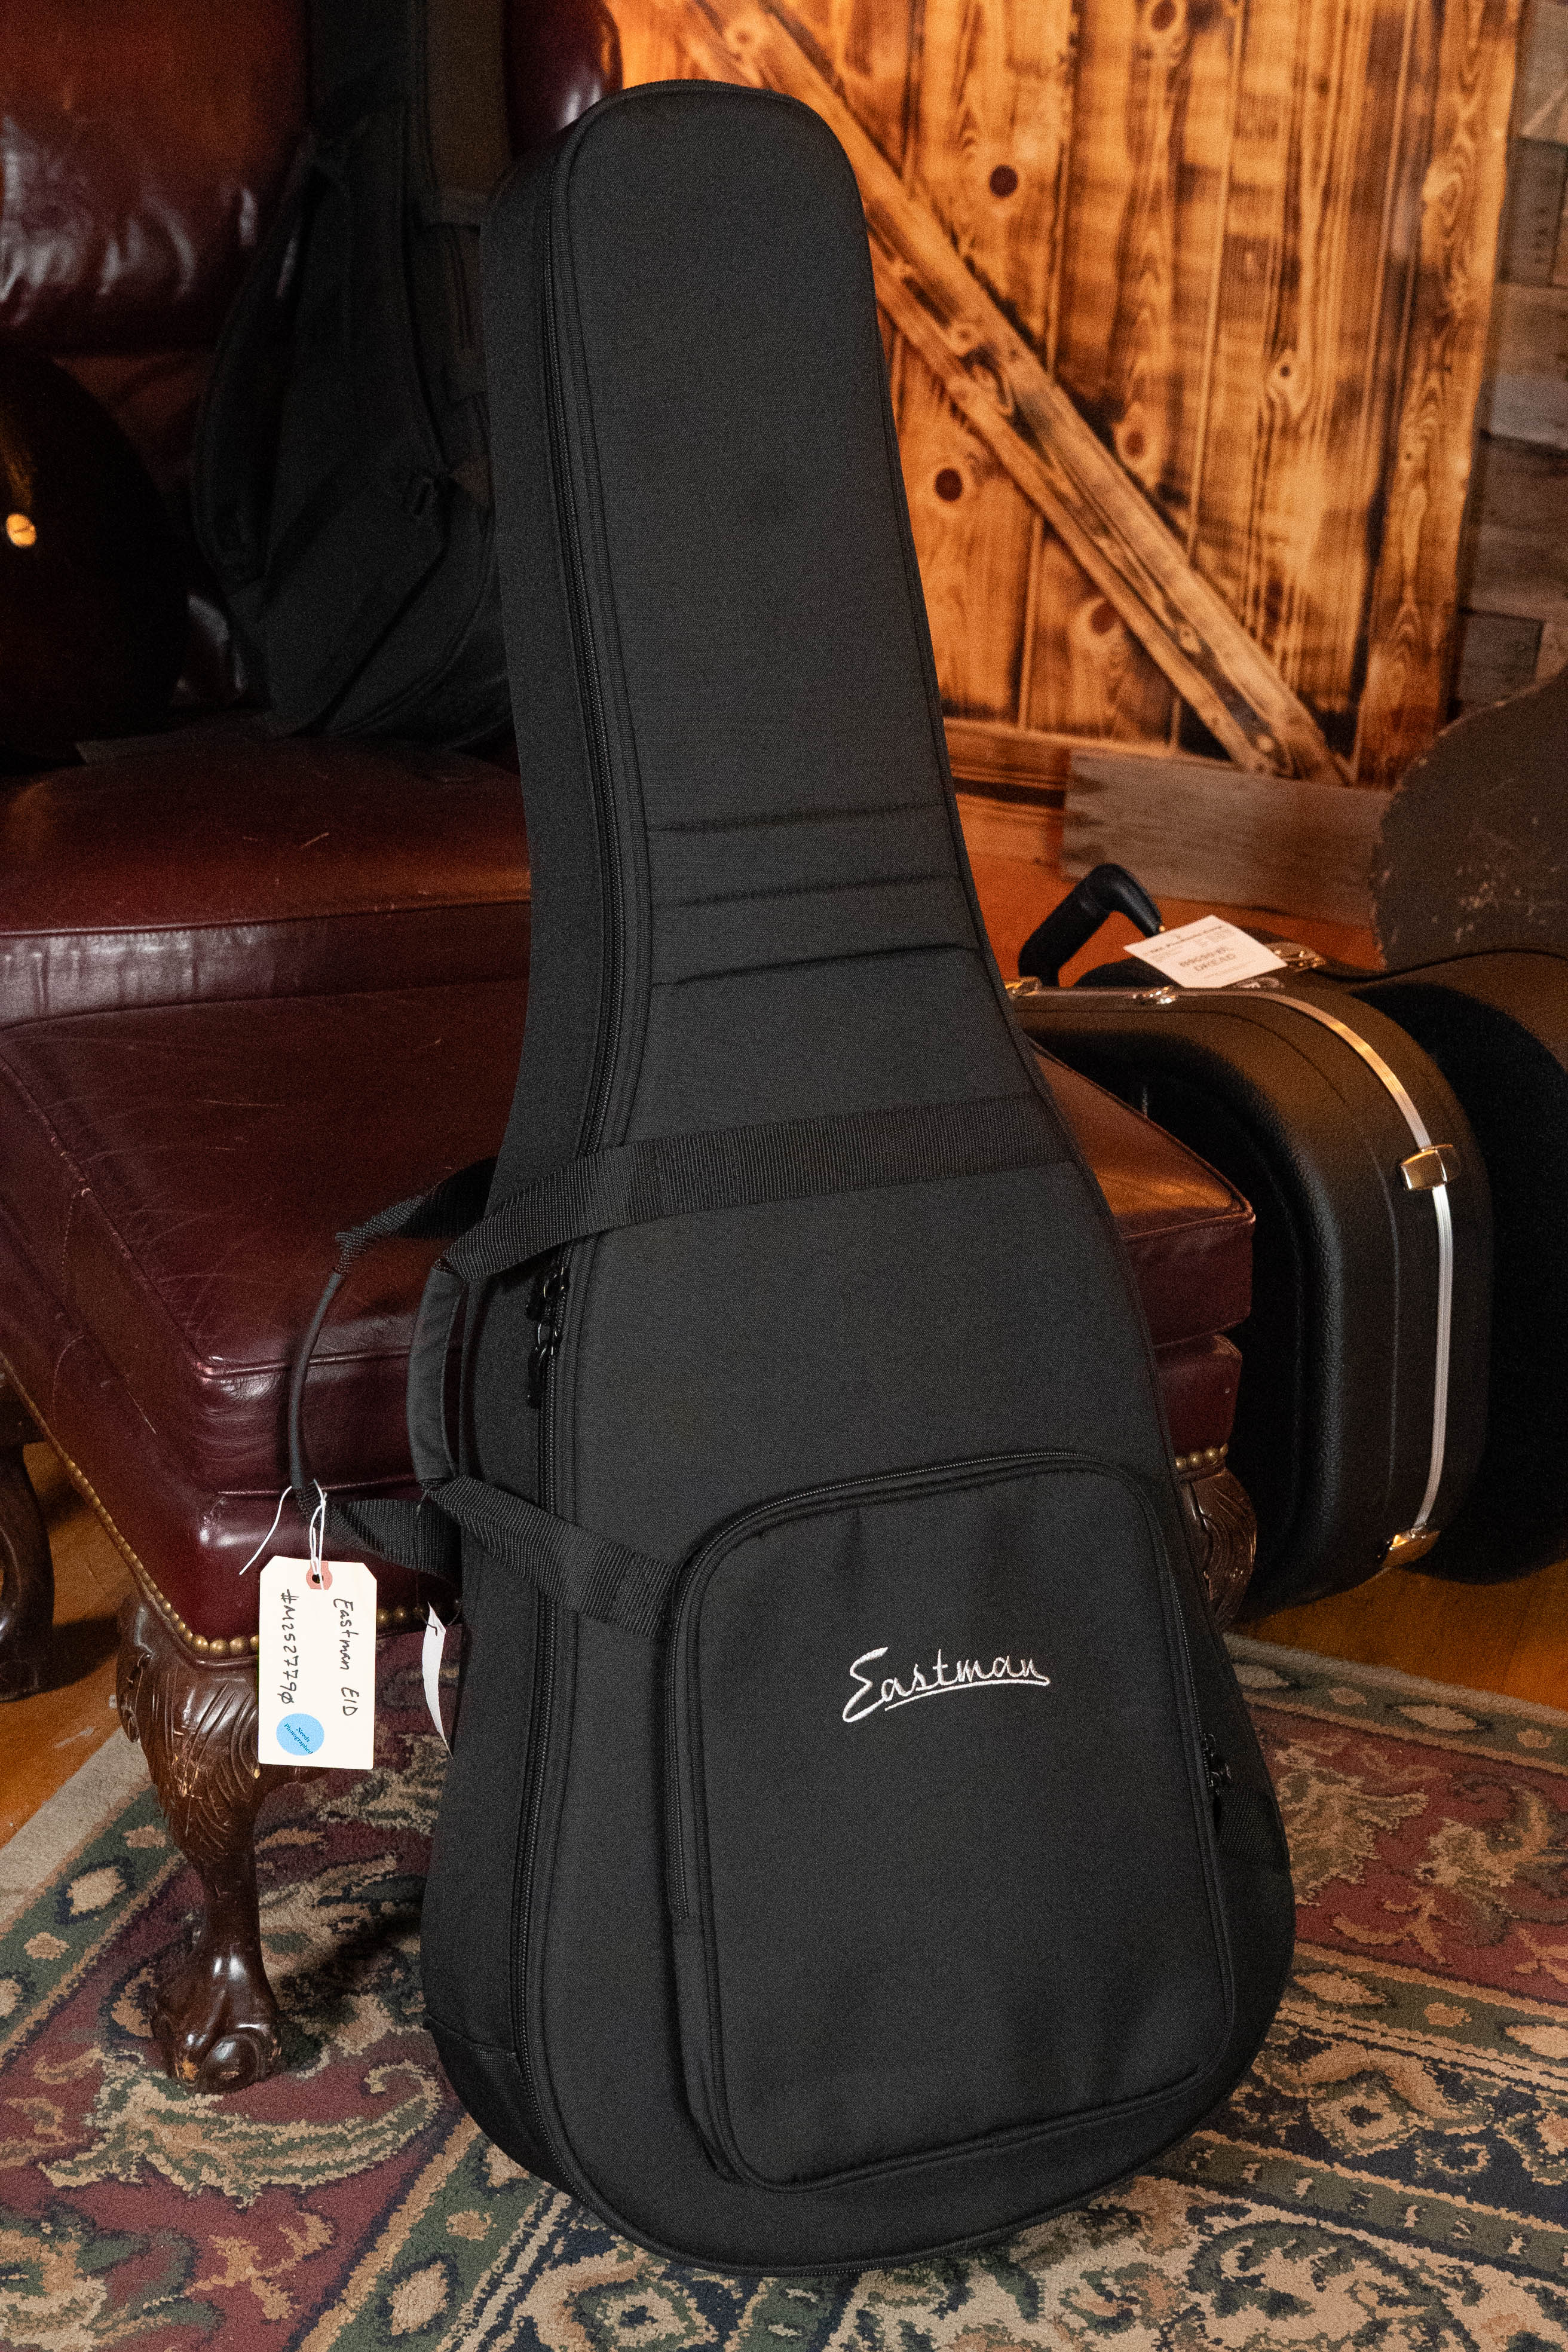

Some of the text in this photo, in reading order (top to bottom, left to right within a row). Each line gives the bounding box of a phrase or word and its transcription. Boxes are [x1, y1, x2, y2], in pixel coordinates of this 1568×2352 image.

[333, 1598, 359, 1670] Eastman
[842, 1646, 1050, 1723] Eastman
[296, 1726, 310, 1742] Needs
